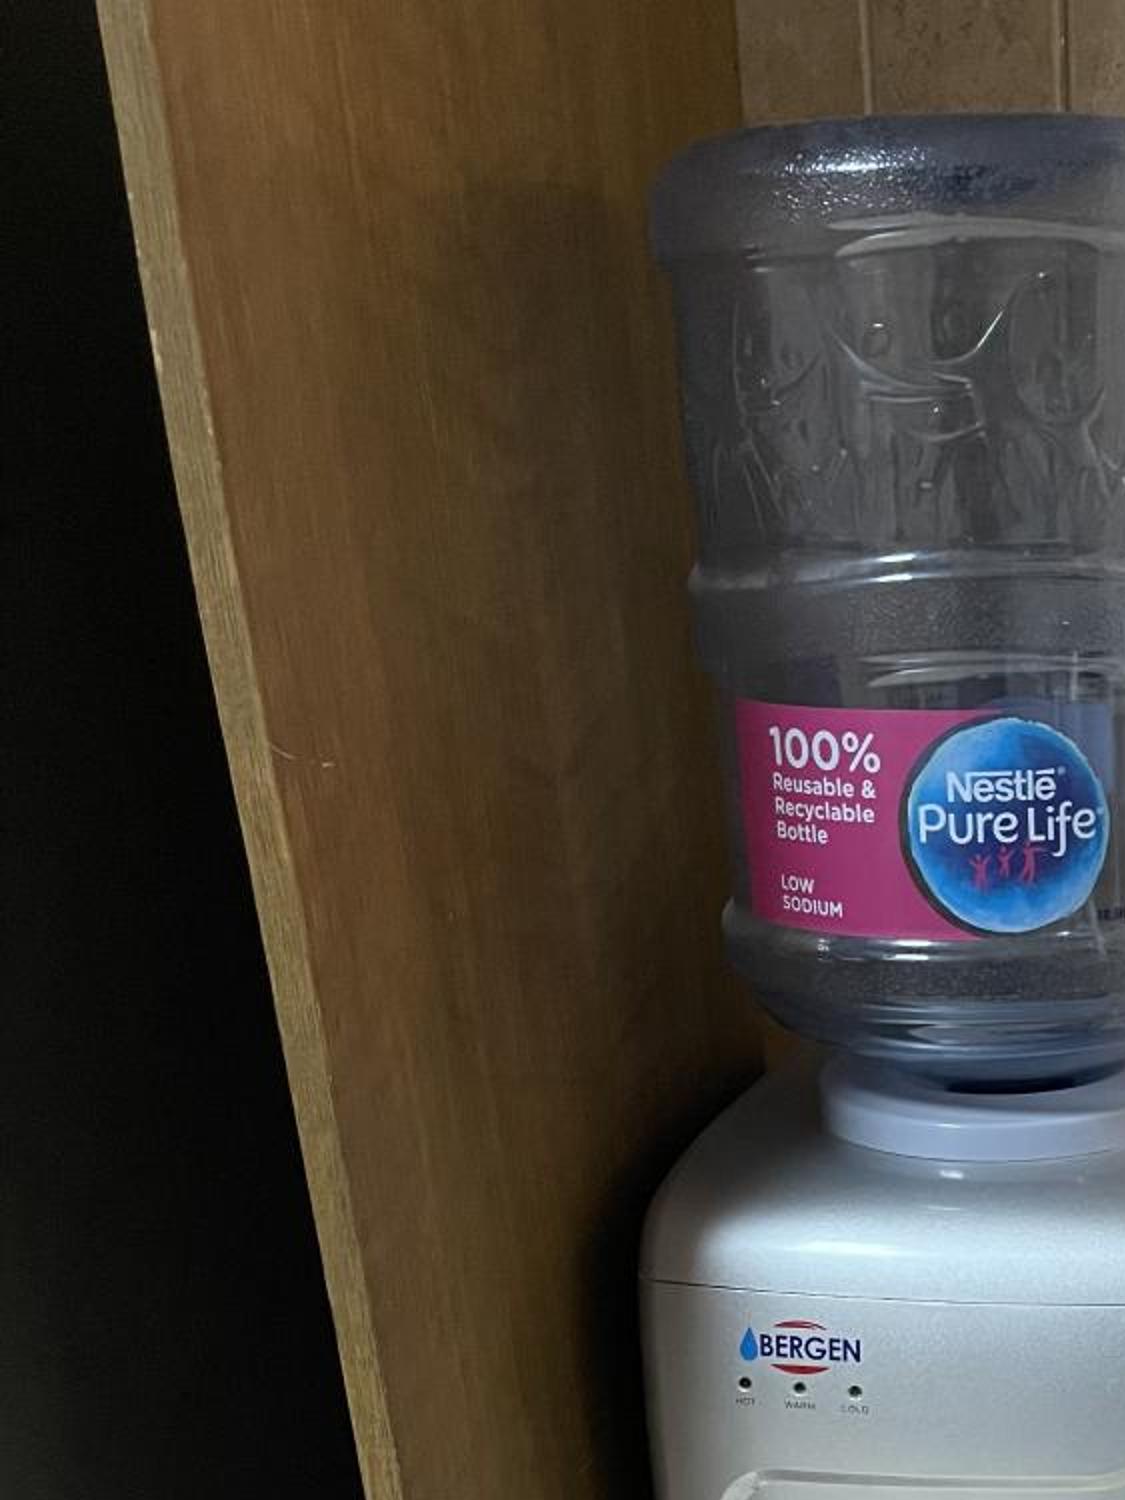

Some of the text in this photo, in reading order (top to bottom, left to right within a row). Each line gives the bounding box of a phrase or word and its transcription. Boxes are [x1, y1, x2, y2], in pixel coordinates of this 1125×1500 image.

[769, 726, 881, 773] 100%
[773, 772, 876, 799] Reusable &
[946, 768, 1057, 803] Nestlé
[775, 797, 875, 823] Recyclable
[777, 821, 829, 844] Bottle
[918, 800, 1096, 857] Pure Life
[781, 875, 815, 894] LOW
[783, 896, 844, 918] SODIUM
[759, 1334, 862, 1363] BERGEN
